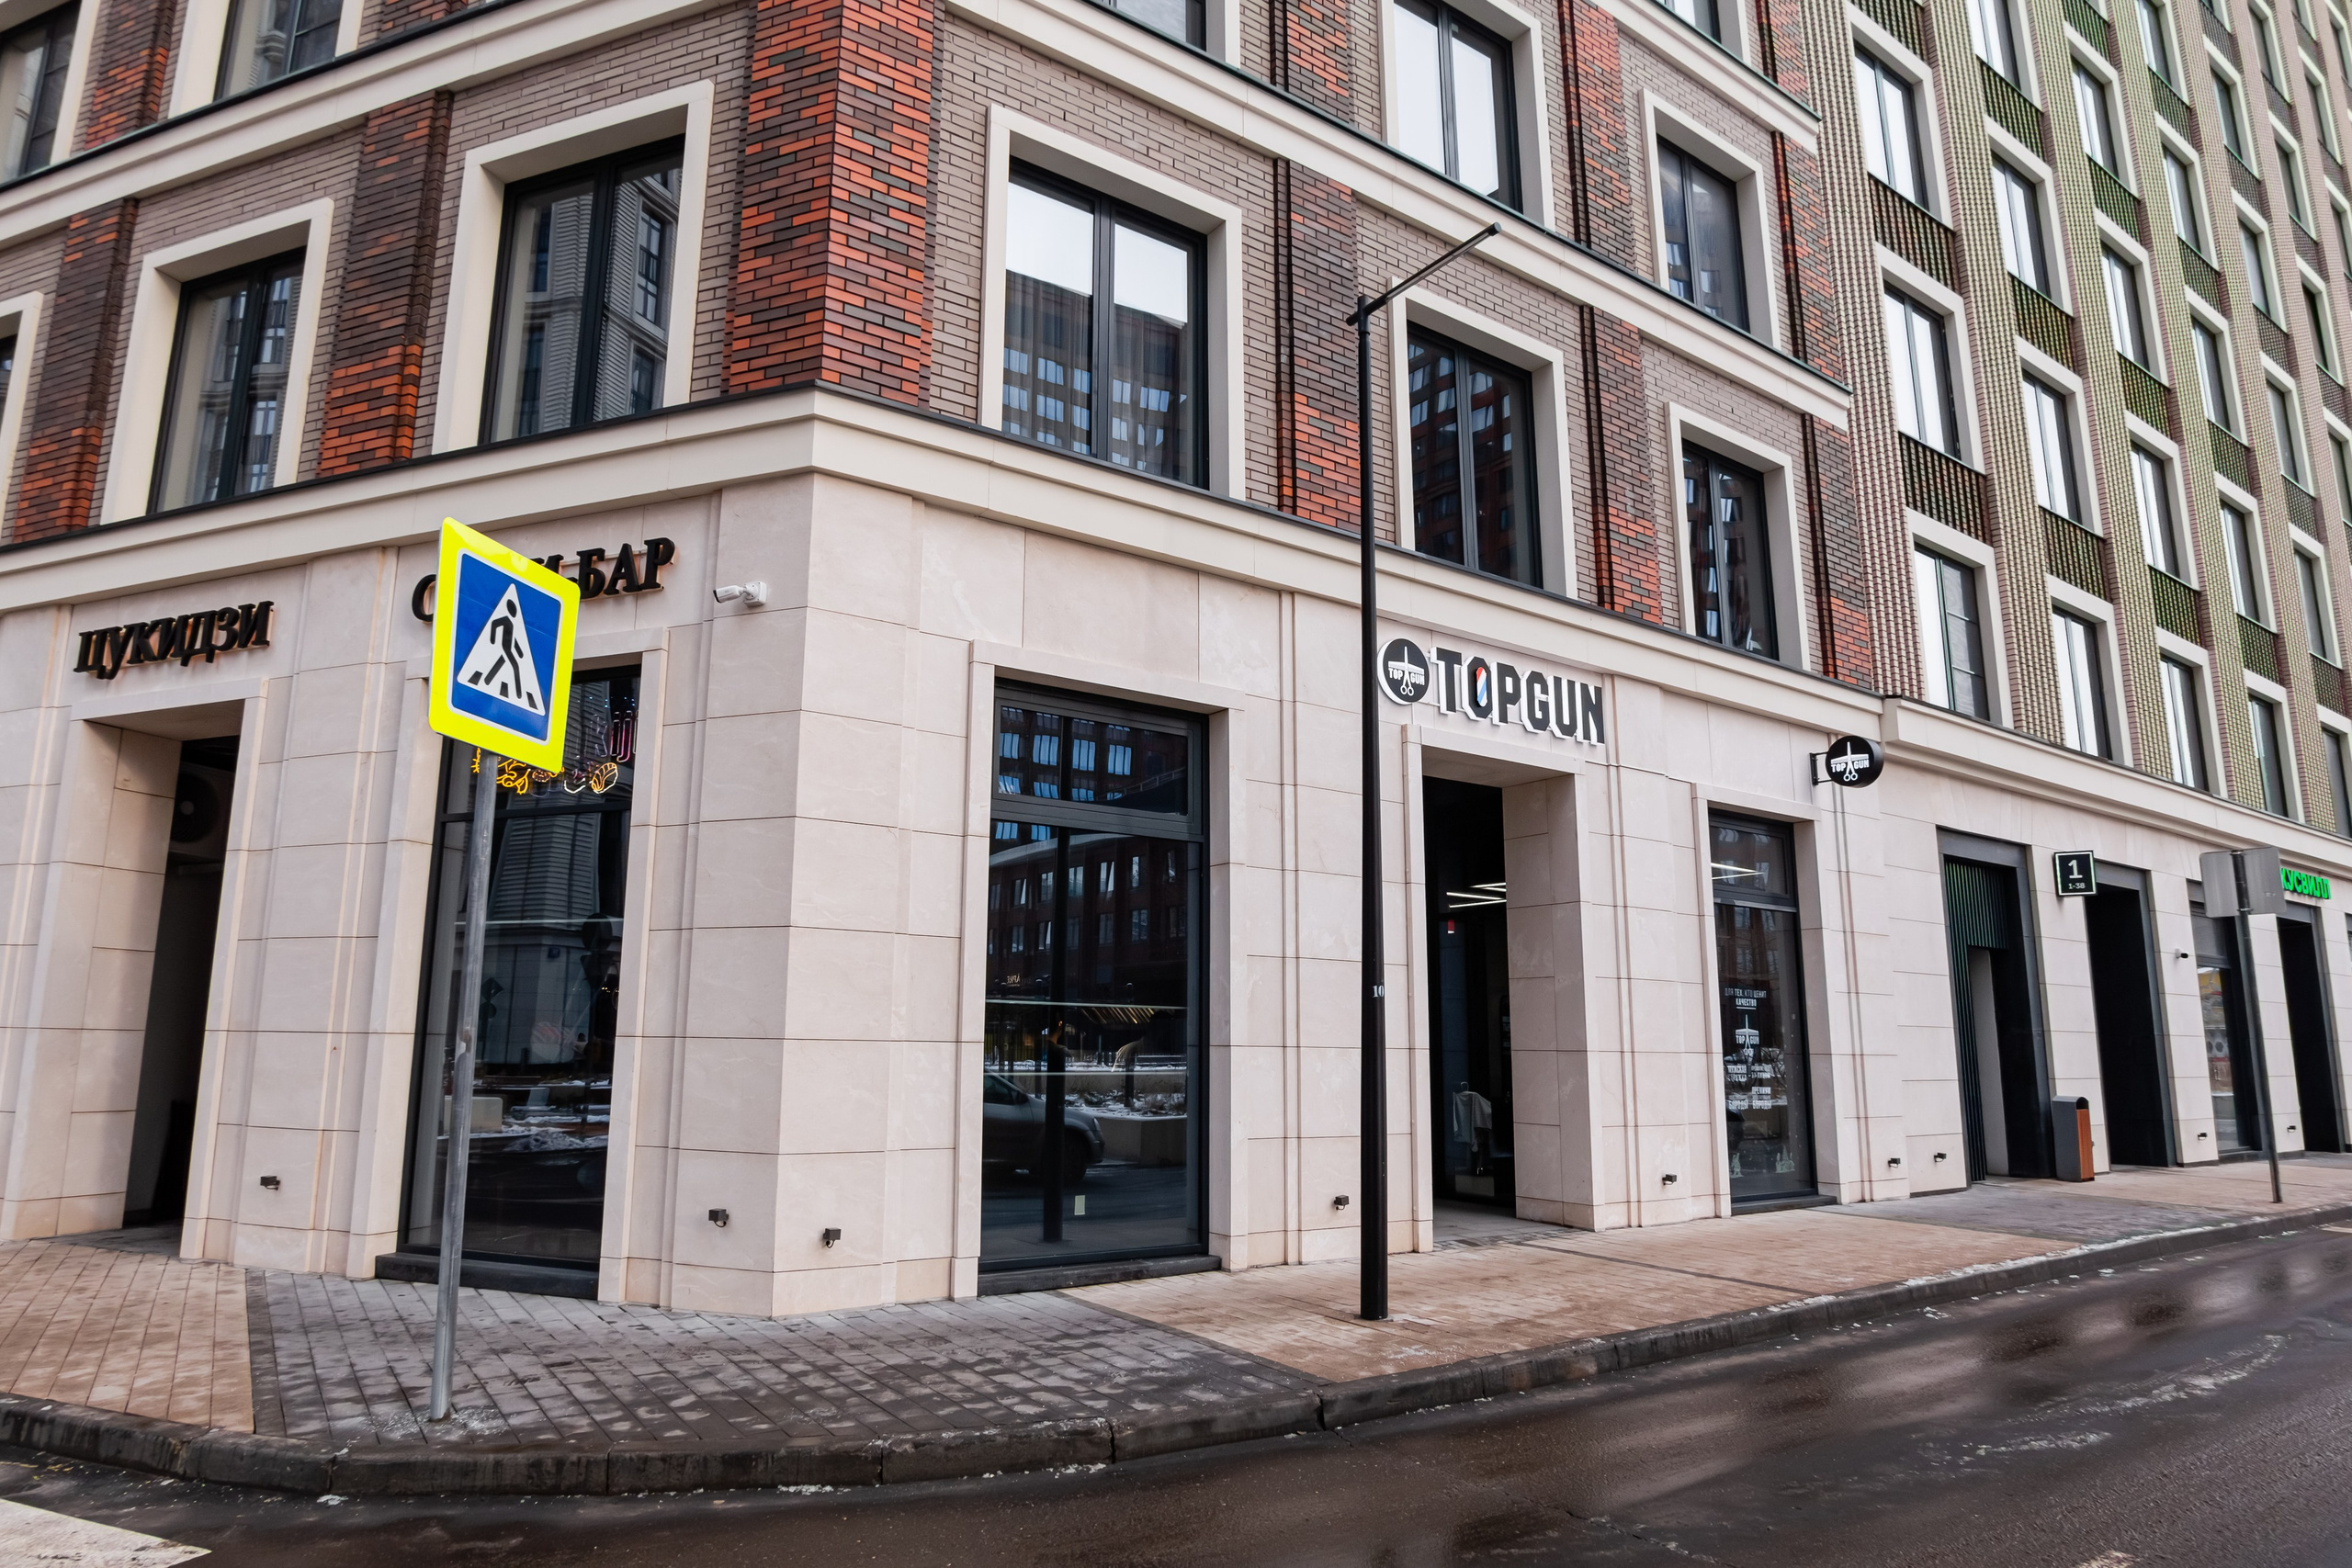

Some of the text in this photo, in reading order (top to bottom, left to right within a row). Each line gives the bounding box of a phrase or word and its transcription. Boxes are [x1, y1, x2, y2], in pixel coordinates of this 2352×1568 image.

[74, 601, 274, 680] ЦУКИДЗИ
[1388, 667, 1425, 685] TOP GUN
[1430, 647, 1605, 745] TOPGUN
[1831, 760, 1869, 773] TOP GUN
[2068, 860, 2083, 879] 1
[2279, 867, 2332, 899] КУСВИЛЛ
[1373, 985, 1385, 998] 10
[1736, 998, 1757, 1007] КАЧЕСТВО
[1736, 1035, 1759, 1044] TOP GUN
